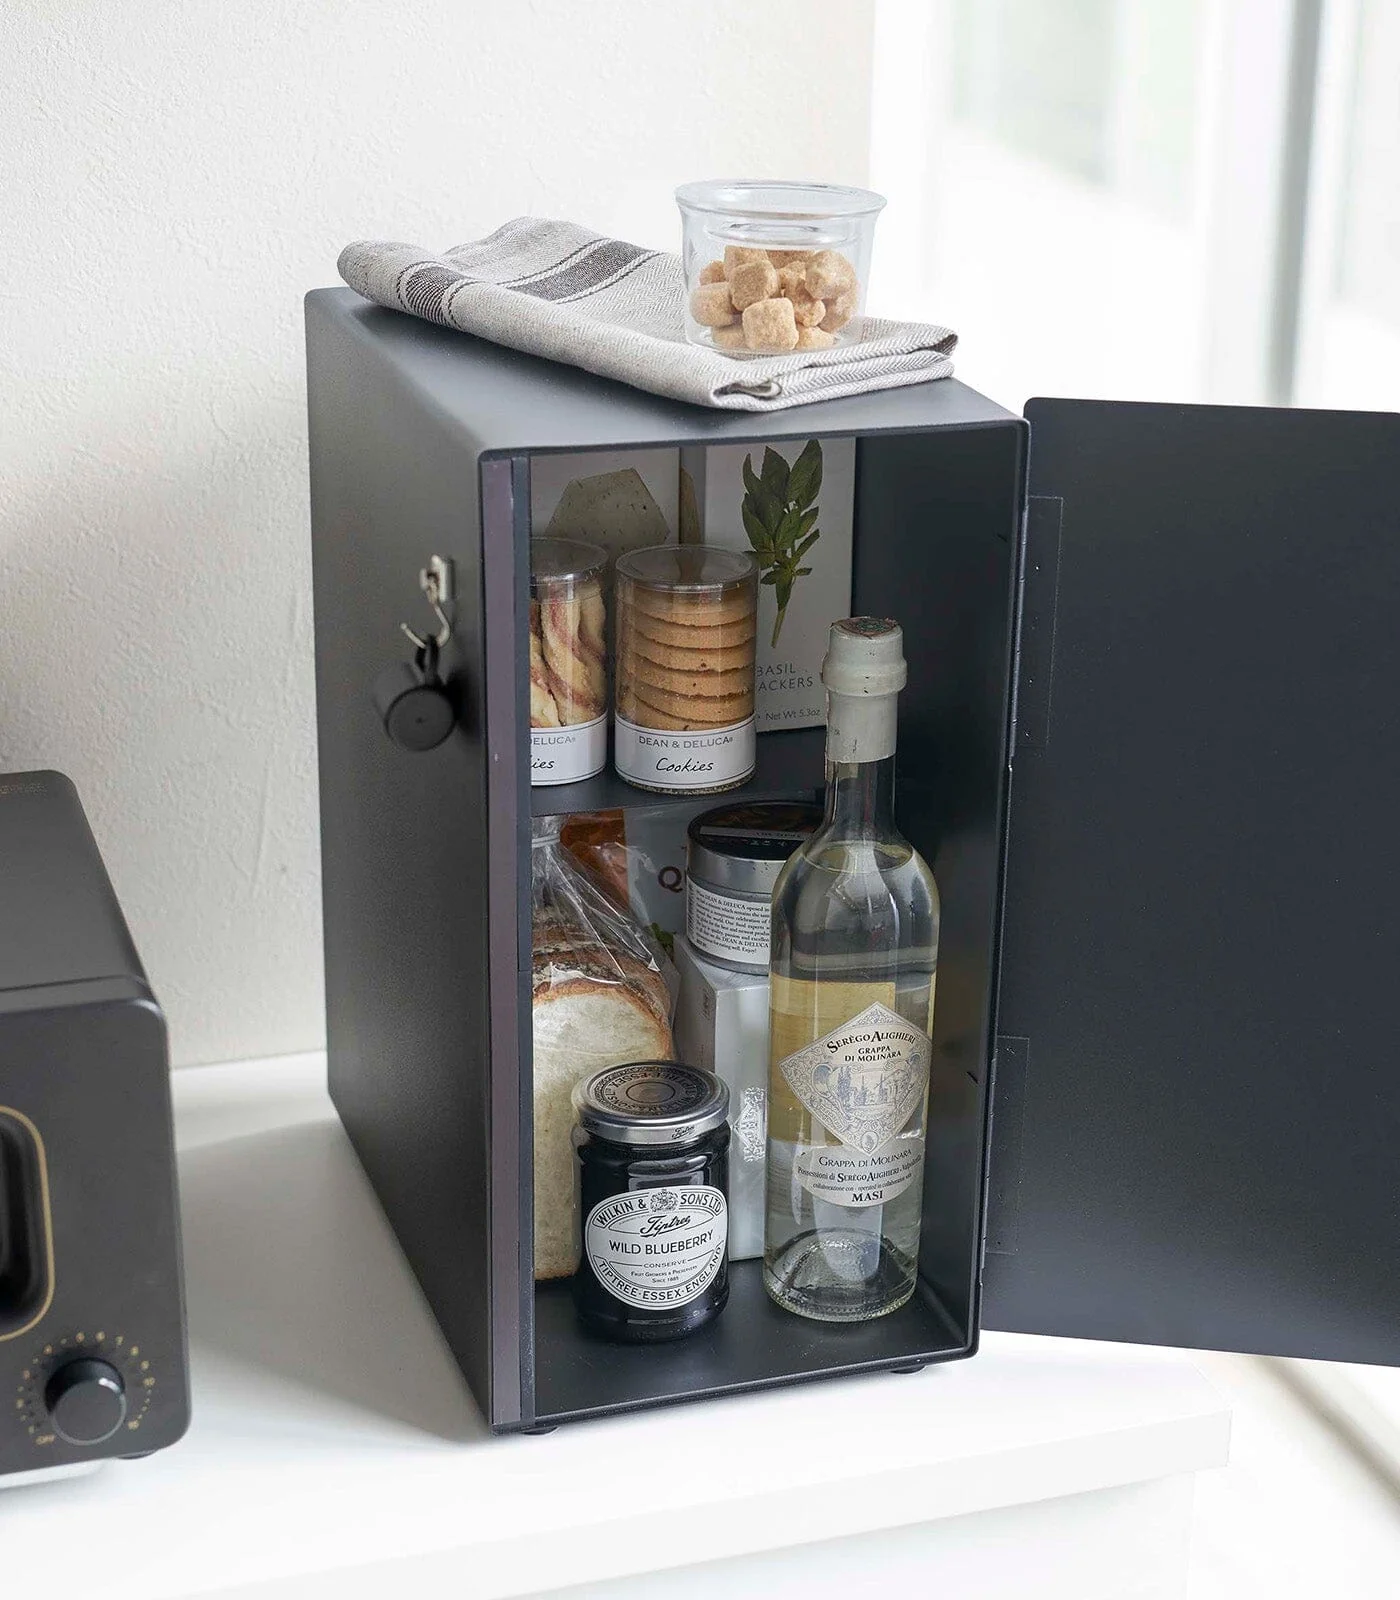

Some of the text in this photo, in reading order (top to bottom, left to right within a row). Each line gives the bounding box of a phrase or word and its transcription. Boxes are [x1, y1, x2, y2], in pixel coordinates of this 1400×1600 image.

[756, 663, 796, 677] BASIL
[765, 712, 780, 720] Net
[531, 735, 572, 746] ELUCA
[639, 736, 668, 748] DEAN
[672, 740, 680, 748] &
[531, 755, 555, 769] ies
[656, 757, 714, 772] Cookies
[858, 1045, 891, 1054] GRAPPA
[857, 1050, 901, 1062] MOLINARA
[818, 1156, 856, 1168] GRAPPA
[858, 1160, 868, 1168] DI
[829, 1173, 836, 1181] di
[851, 1190, 884, 1202] MASI
[596, 1200, 634, 1225] WILKIN
[638, 1199, 647, 1209] &
[680, 1193, 708, 1205] SONS
[708, 1197, 722, 1213] LTD
[640, 1215, 691, 1237] Tiptree
[609, 1229, 713, 1255] WILD BLUEBERRY
[643, 1259, 687, 1269] CONSERVE
[599, 1247, 721, 1301] TIPTREE ESSEX ENGLAND
